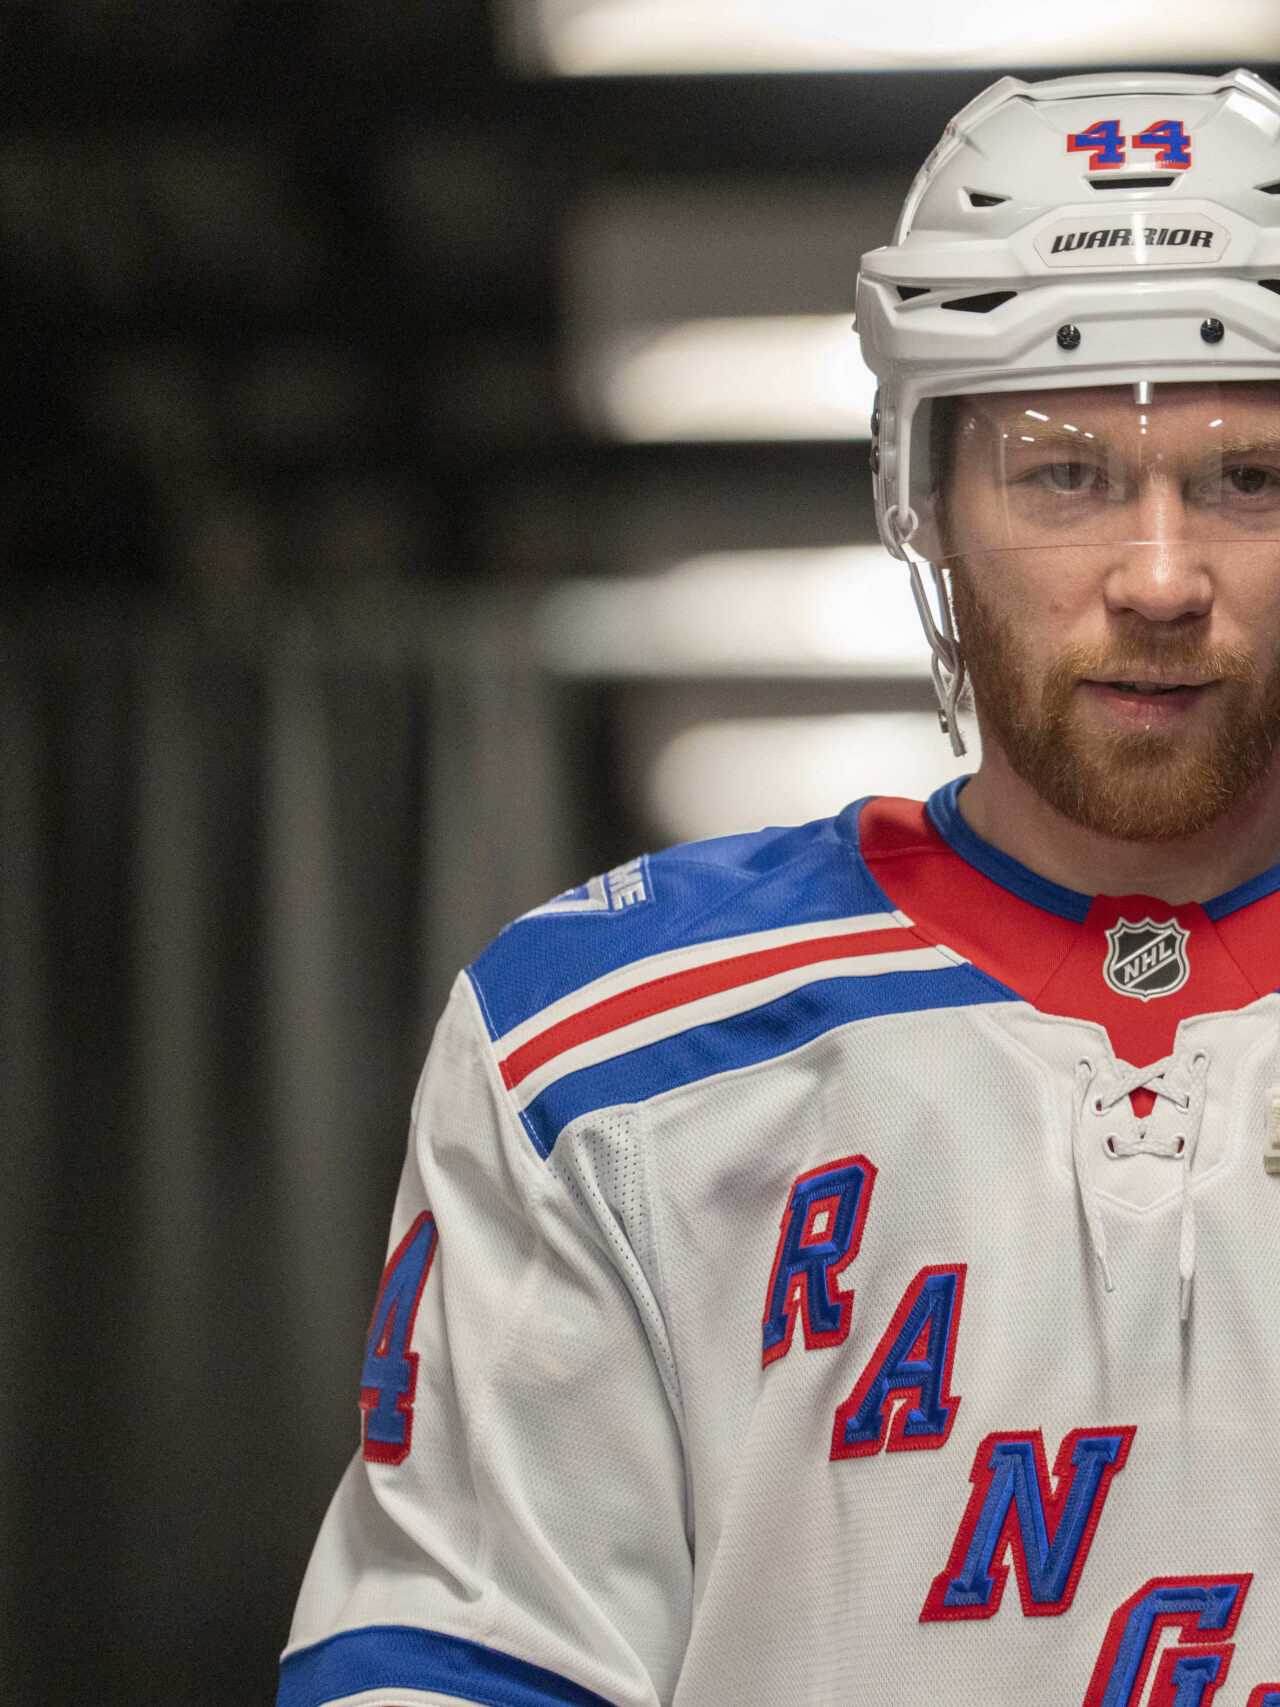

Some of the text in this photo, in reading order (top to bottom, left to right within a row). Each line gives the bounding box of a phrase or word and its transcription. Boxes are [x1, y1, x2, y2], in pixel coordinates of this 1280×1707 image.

[1066, 119, 1192, 171] 44
[1050, 227, 1215, 254] WARRIOR
[1122, 939, 1174, 984] NHL
